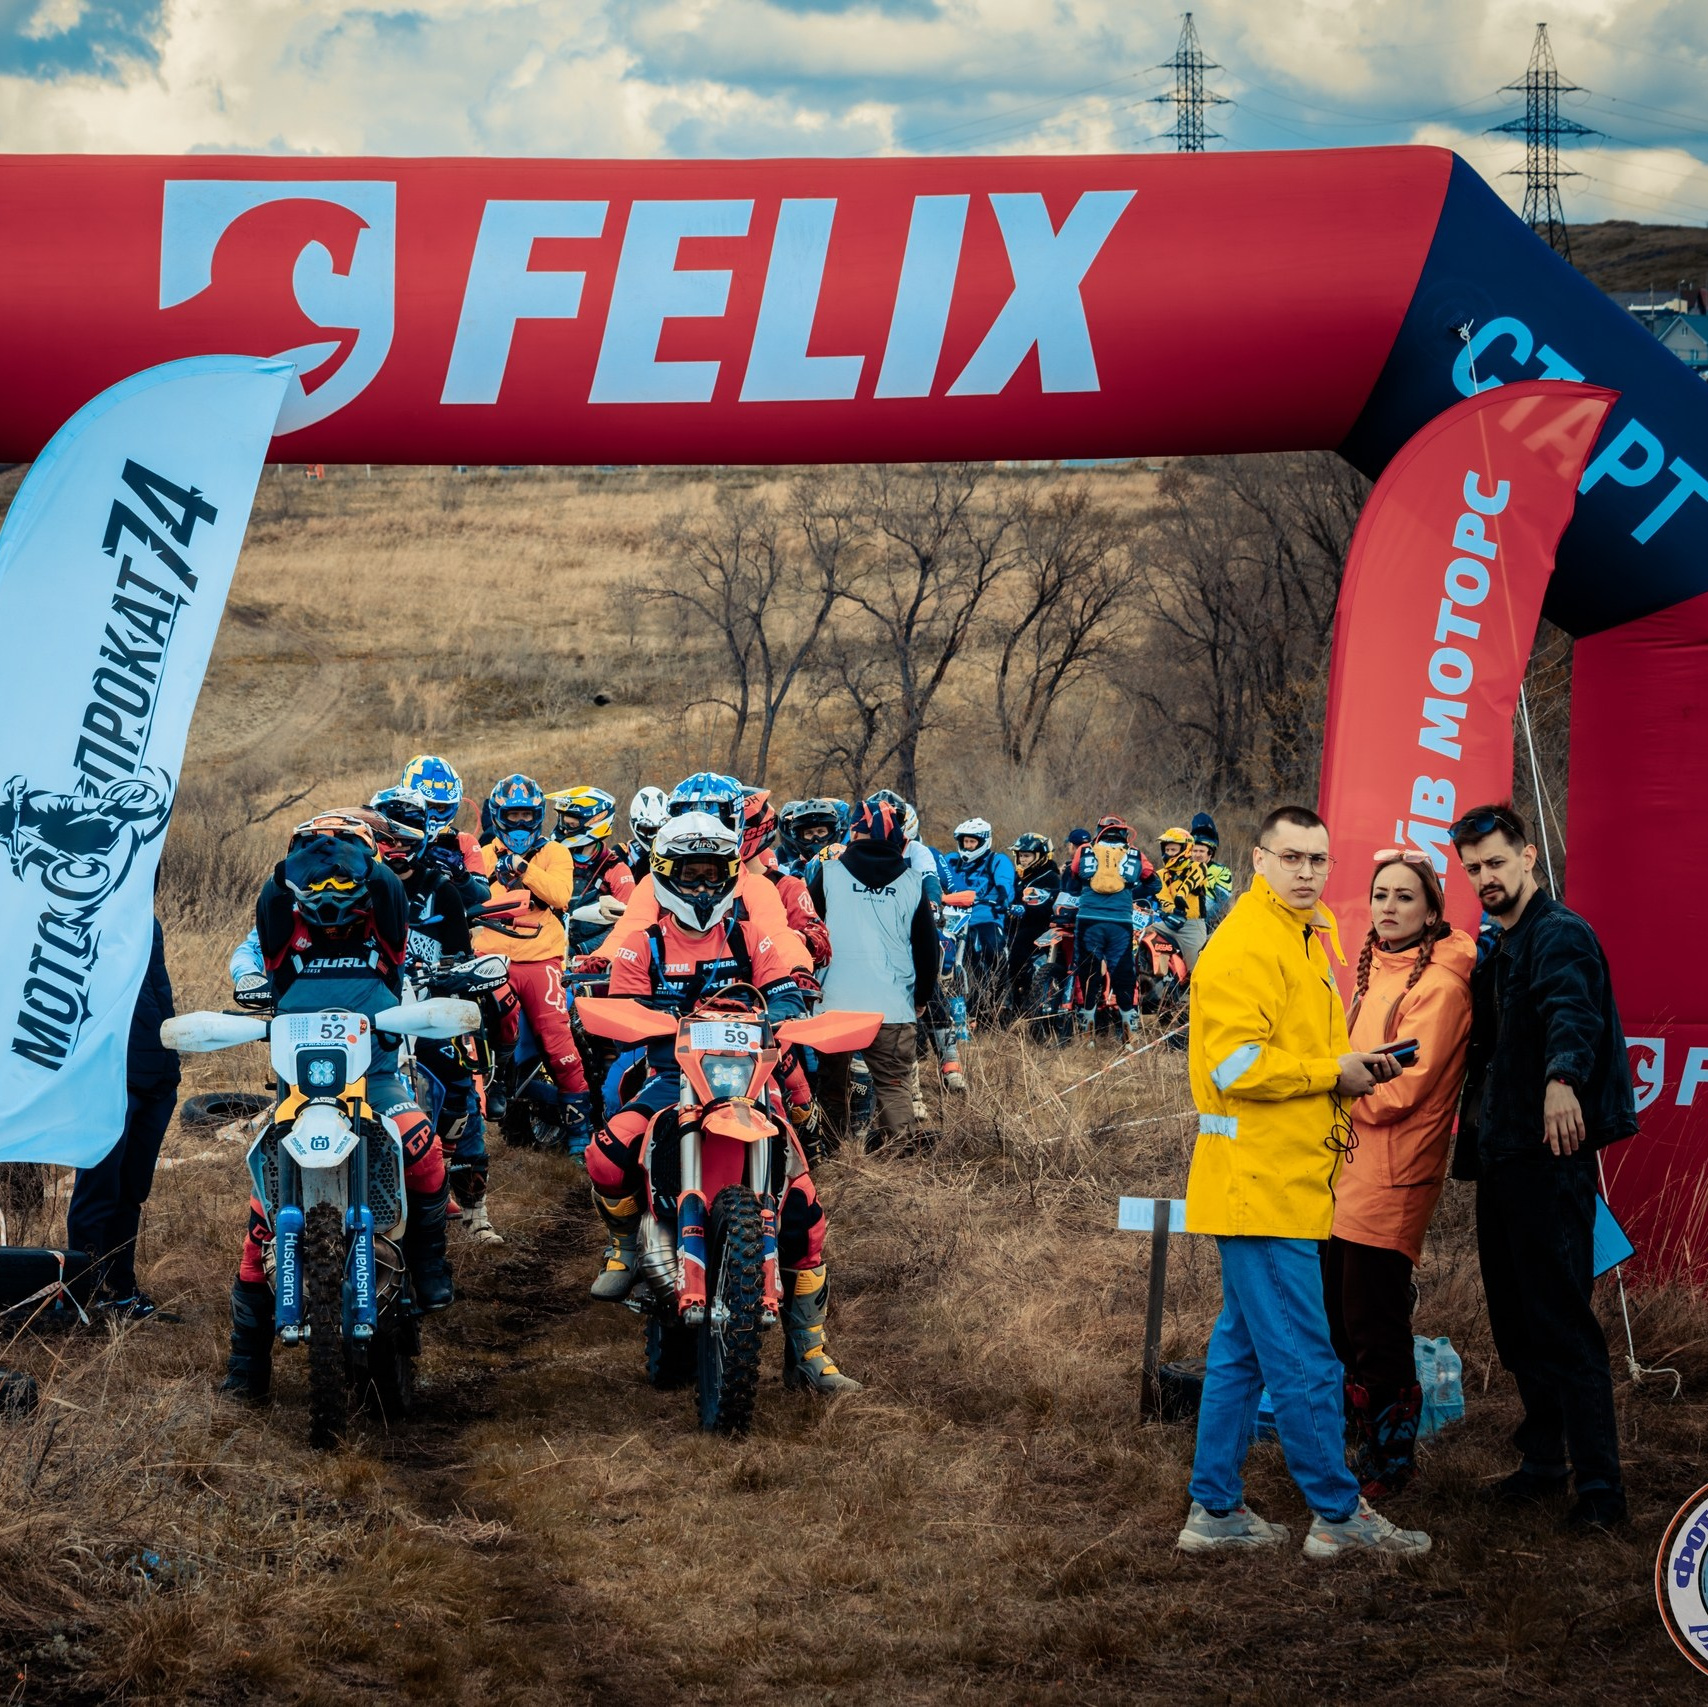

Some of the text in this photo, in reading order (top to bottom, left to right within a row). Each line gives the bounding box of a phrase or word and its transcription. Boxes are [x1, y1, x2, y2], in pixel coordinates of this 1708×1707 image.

[440, 189, 1138, 404] FELIX
[1394, 470, 1510, 893] ЙВ МОТОРС
[11, 458, 218, 1071] МОТО ПРОКАТ74
[690, 840, 718, 850] Airoh
[852, 883, 896, 897] LAVR
[320, 1024, 346, 1040] 52
[724, 1029, 749, 1045] 59
[560, 1053, 577, 1065] FOX
[405, 1125, 431, 1156] GP
[283, 1232, 298, 1307] Husqvarna
[354, 1234, 369, 1308] Husqvarna
